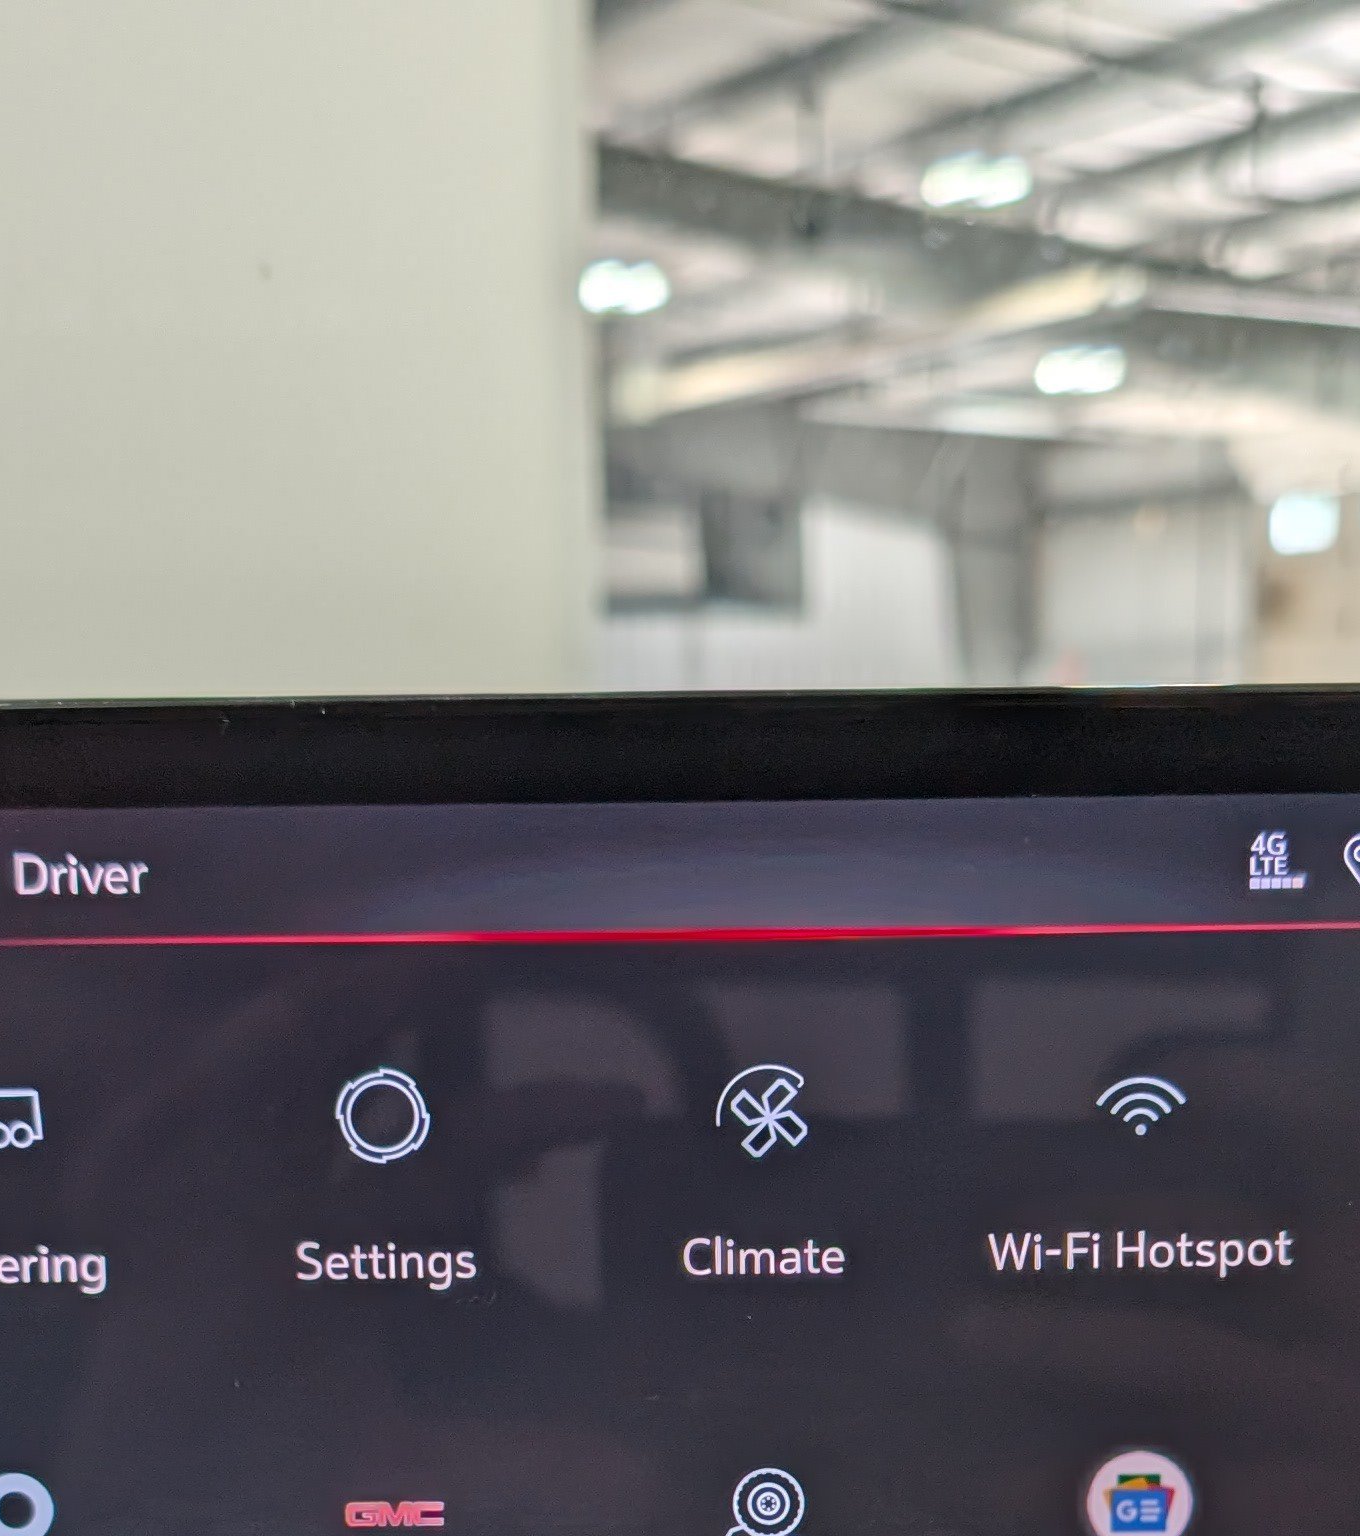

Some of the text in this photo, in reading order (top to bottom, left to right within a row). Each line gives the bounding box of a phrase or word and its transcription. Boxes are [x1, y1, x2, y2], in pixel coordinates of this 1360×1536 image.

[1251, 832, 1288, 856] 4G
[14, 853, 148, 895] Driver
[1250, 857, 1288, 876] LTE
[297, 1242, 476, 1290] Settings
[683, 1236, 845, 1275] Climate
[988, 1231, 1292, 1277] Wi-Fi Hotspot
[345, 1501, 444, 1527] GMC
